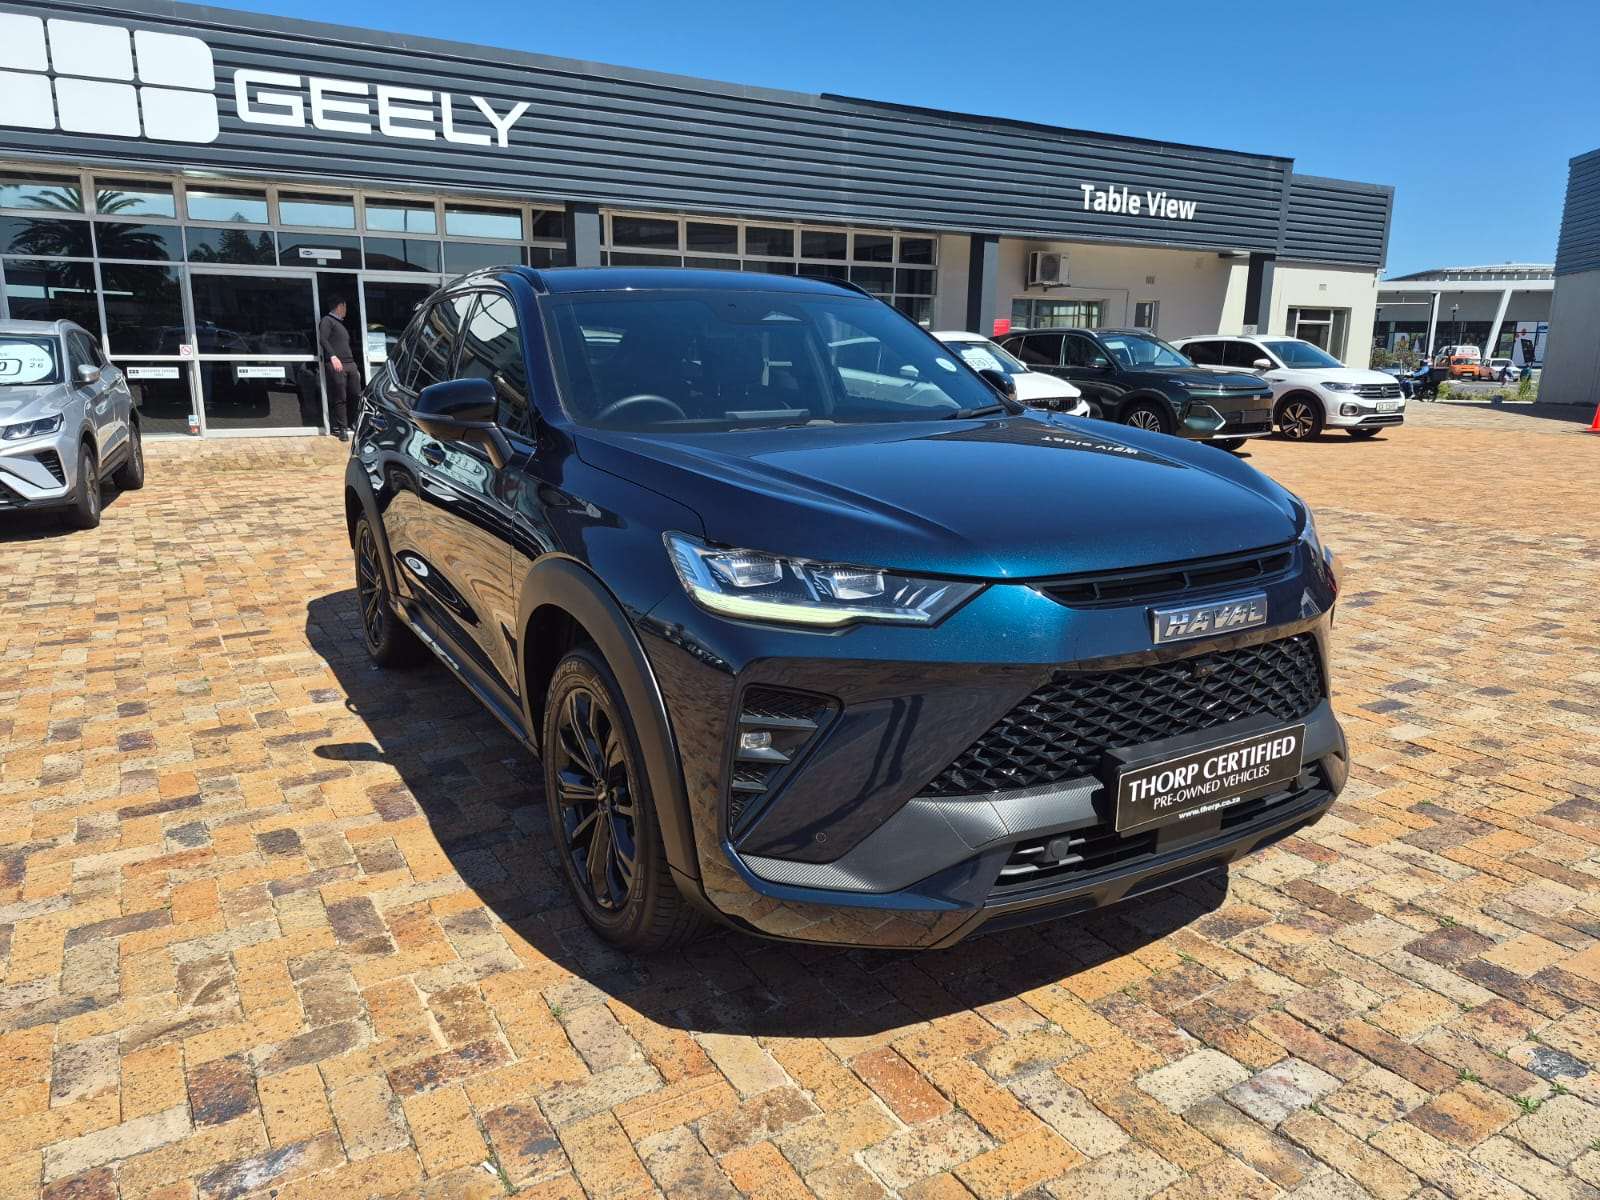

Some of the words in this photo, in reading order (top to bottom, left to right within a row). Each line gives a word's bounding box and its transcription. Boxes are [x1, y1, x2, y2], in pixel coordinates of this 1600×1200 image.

[234, 69, 531, 148] GEELY
[1081, 184, 1140, 215] Table
[1146, 191, 1197, 220] View
[1165, 601, 1264, 637] HAVAL
[1128, 763, 1199, 802] THORP
[1203, 735, 1296, 779] CERTIFIED
[1153, 779, 1221, 810] PRE-OWNED
[1223, 764, 1270, 788] VEHICLES
[1178, 796, 1241, 819] www.thorp.co.za
